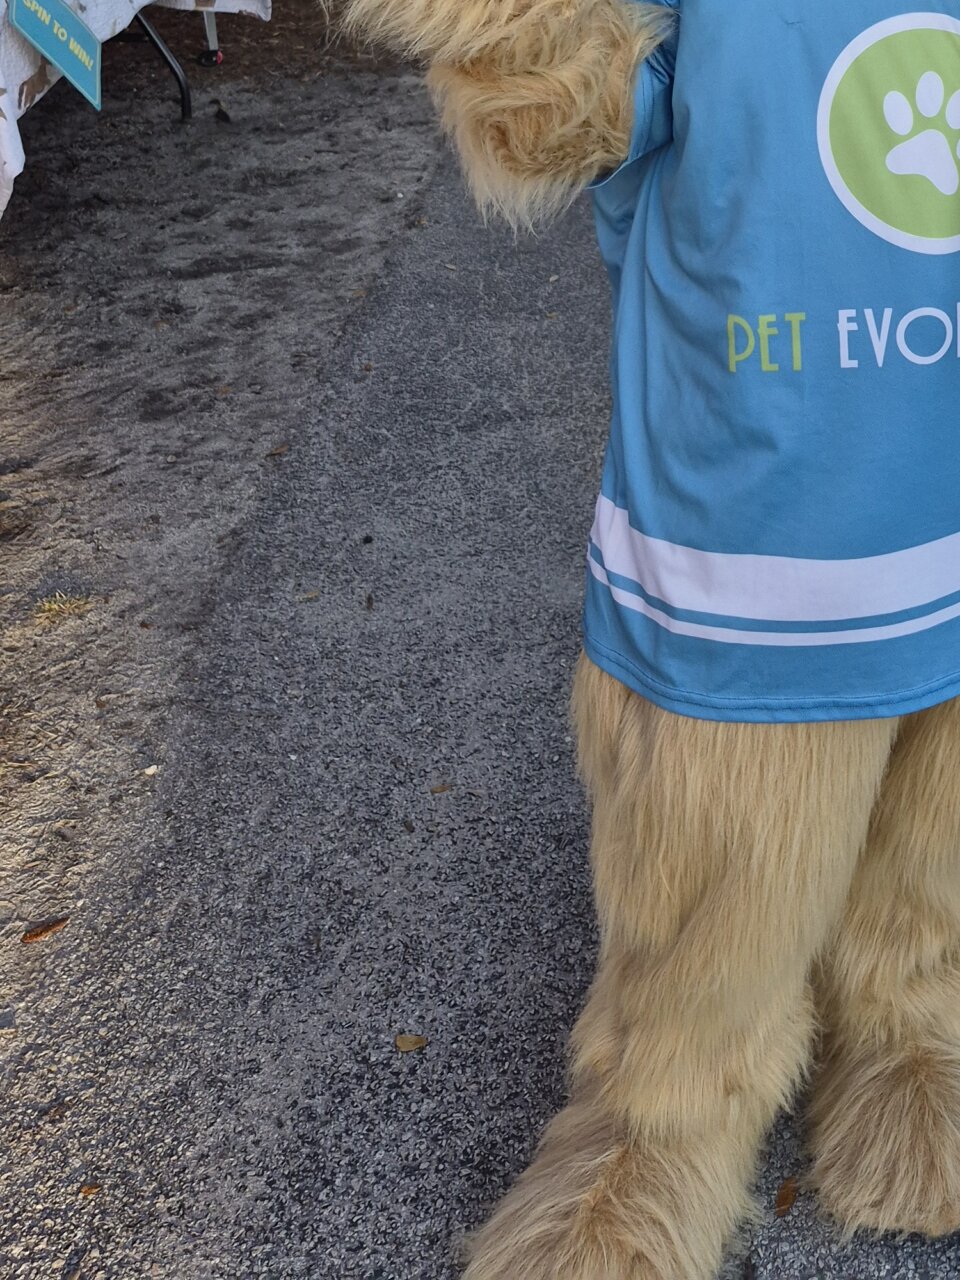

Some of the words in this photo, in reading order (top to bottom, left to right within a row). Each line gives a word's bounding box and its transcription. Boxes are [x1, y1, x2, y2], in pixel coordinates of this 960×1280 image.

[53, 20, 68, 41] TO
[69, 38, 94, 71] WIN!
[726, 312, 806, 373] PET
